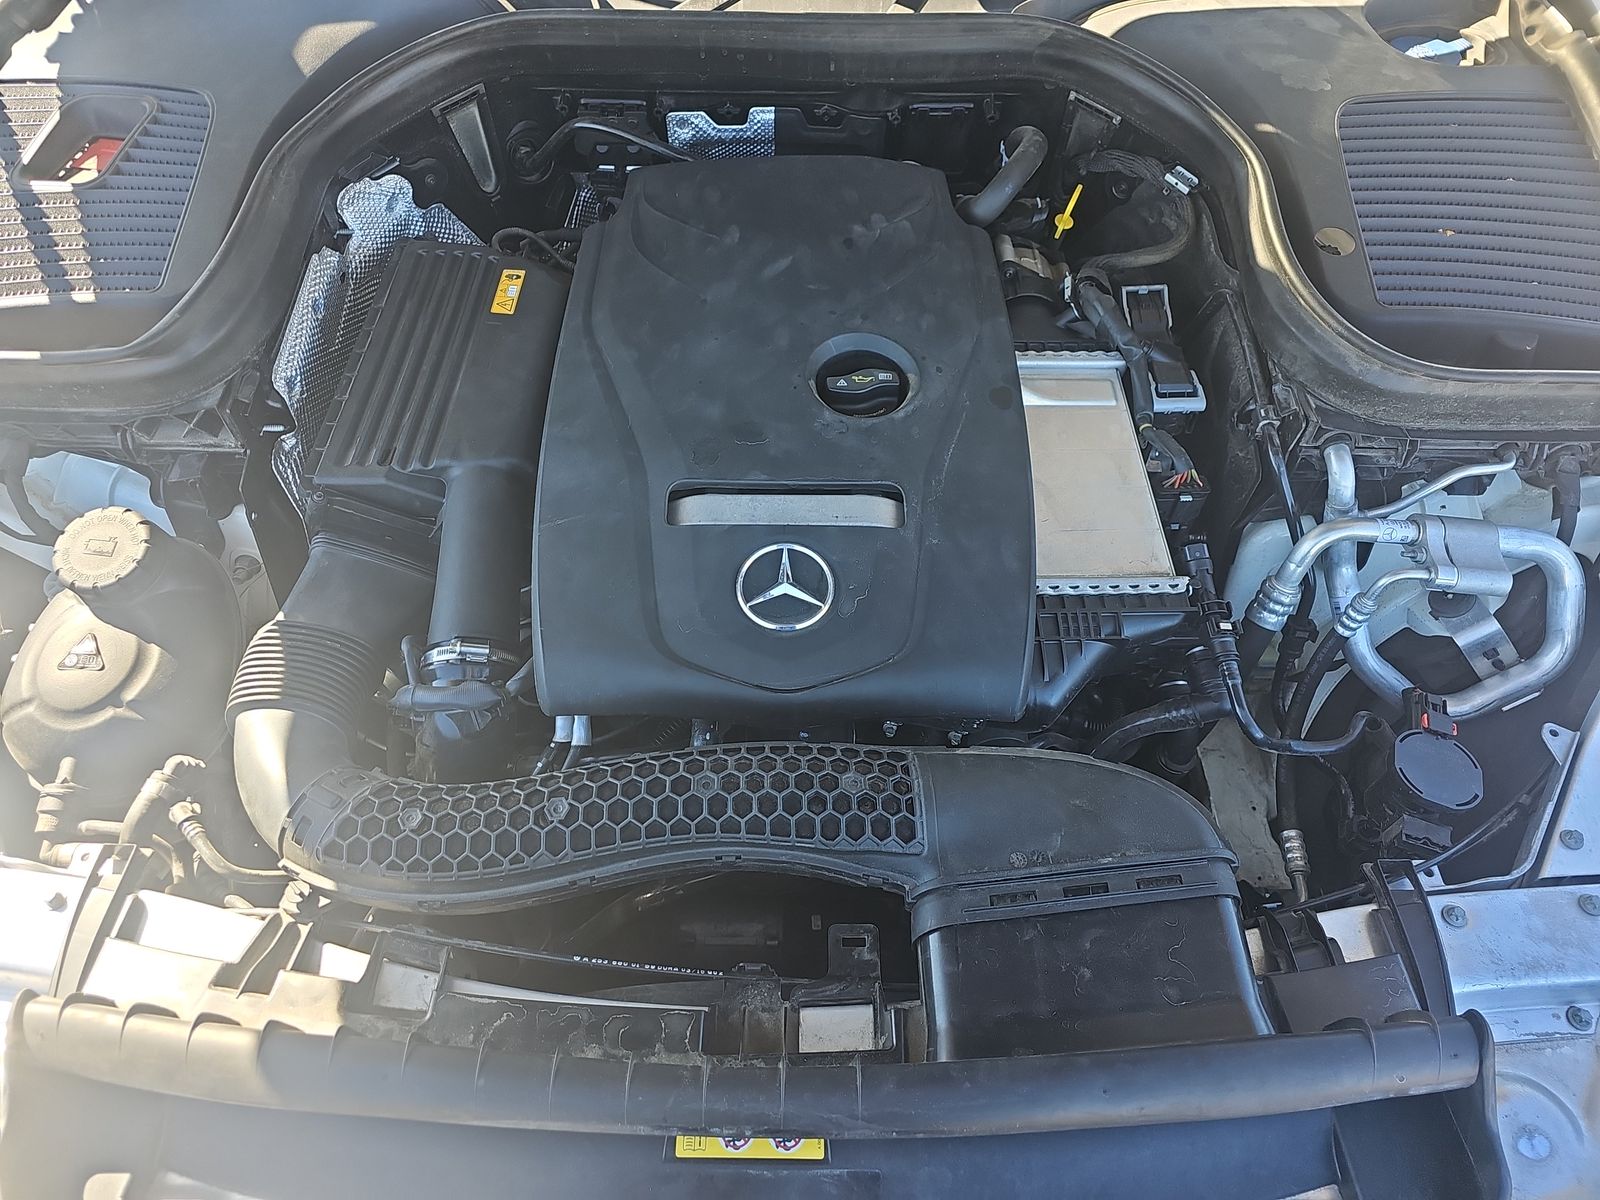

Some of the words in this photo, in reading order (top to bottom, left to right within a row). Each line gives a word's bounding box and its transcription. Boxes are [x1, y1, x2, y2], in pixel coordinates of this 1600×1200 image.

[80, 517, 96, 529] NOT
[97, 514, 118, 523] OPEN
[118, 515, 137, 533] WHEN
